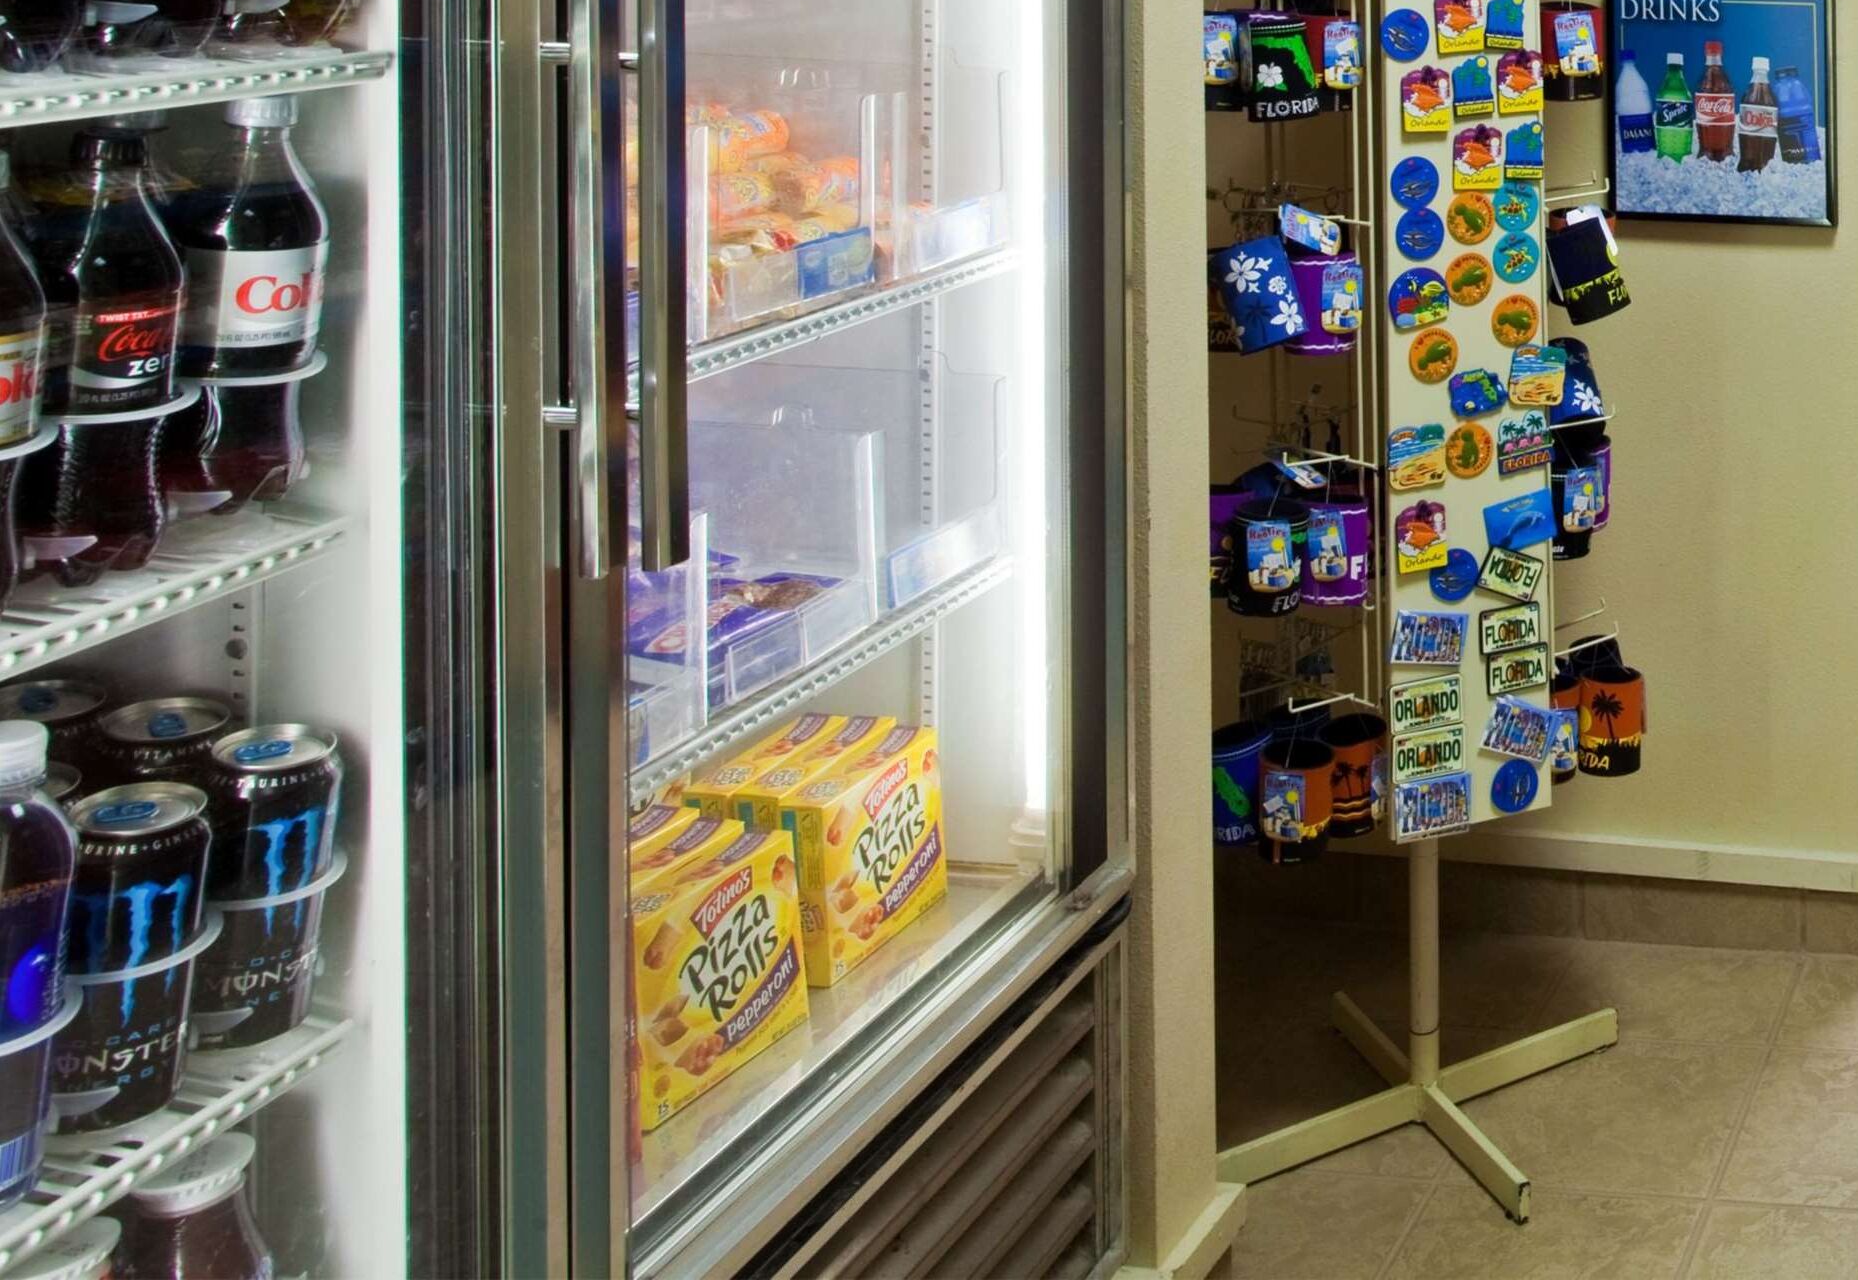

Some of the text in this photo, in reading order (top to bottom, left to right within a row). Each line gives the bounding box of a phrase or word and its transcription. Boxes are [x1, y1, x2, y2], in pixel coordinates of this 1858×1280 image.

[1255, 95, 1320, 118] FLORIDA
[1662, 103, 1689, 123] Sprite
[236, 273, 323, 315] Cok
[127, 352, 173, 377] zer
[1503, 449, 1552, 473] FLORIDA
[1404, 552, 1444, 569] Orlando
[1485, 617, 1536, 646] FLORIDA
[1492, 658, 1543, 687] FLORIDA
[1395, 689, 1458, 723] ORLANDO
[1397, 738, 1461, 771] ORLANDO
[865, 764, 908, 818] Totino's
[852, 782, 921, 868] Pizza
[867, 810, 926, 894] Rolls
[884, 837, 937, 912] pepperoni
[696, 869, 751, 933] Totino's
[678, 894, 770, 995] Pizza
[698, 925, 779, 1022] Rolls
[726, 949, 794, 1042] pepperoni
